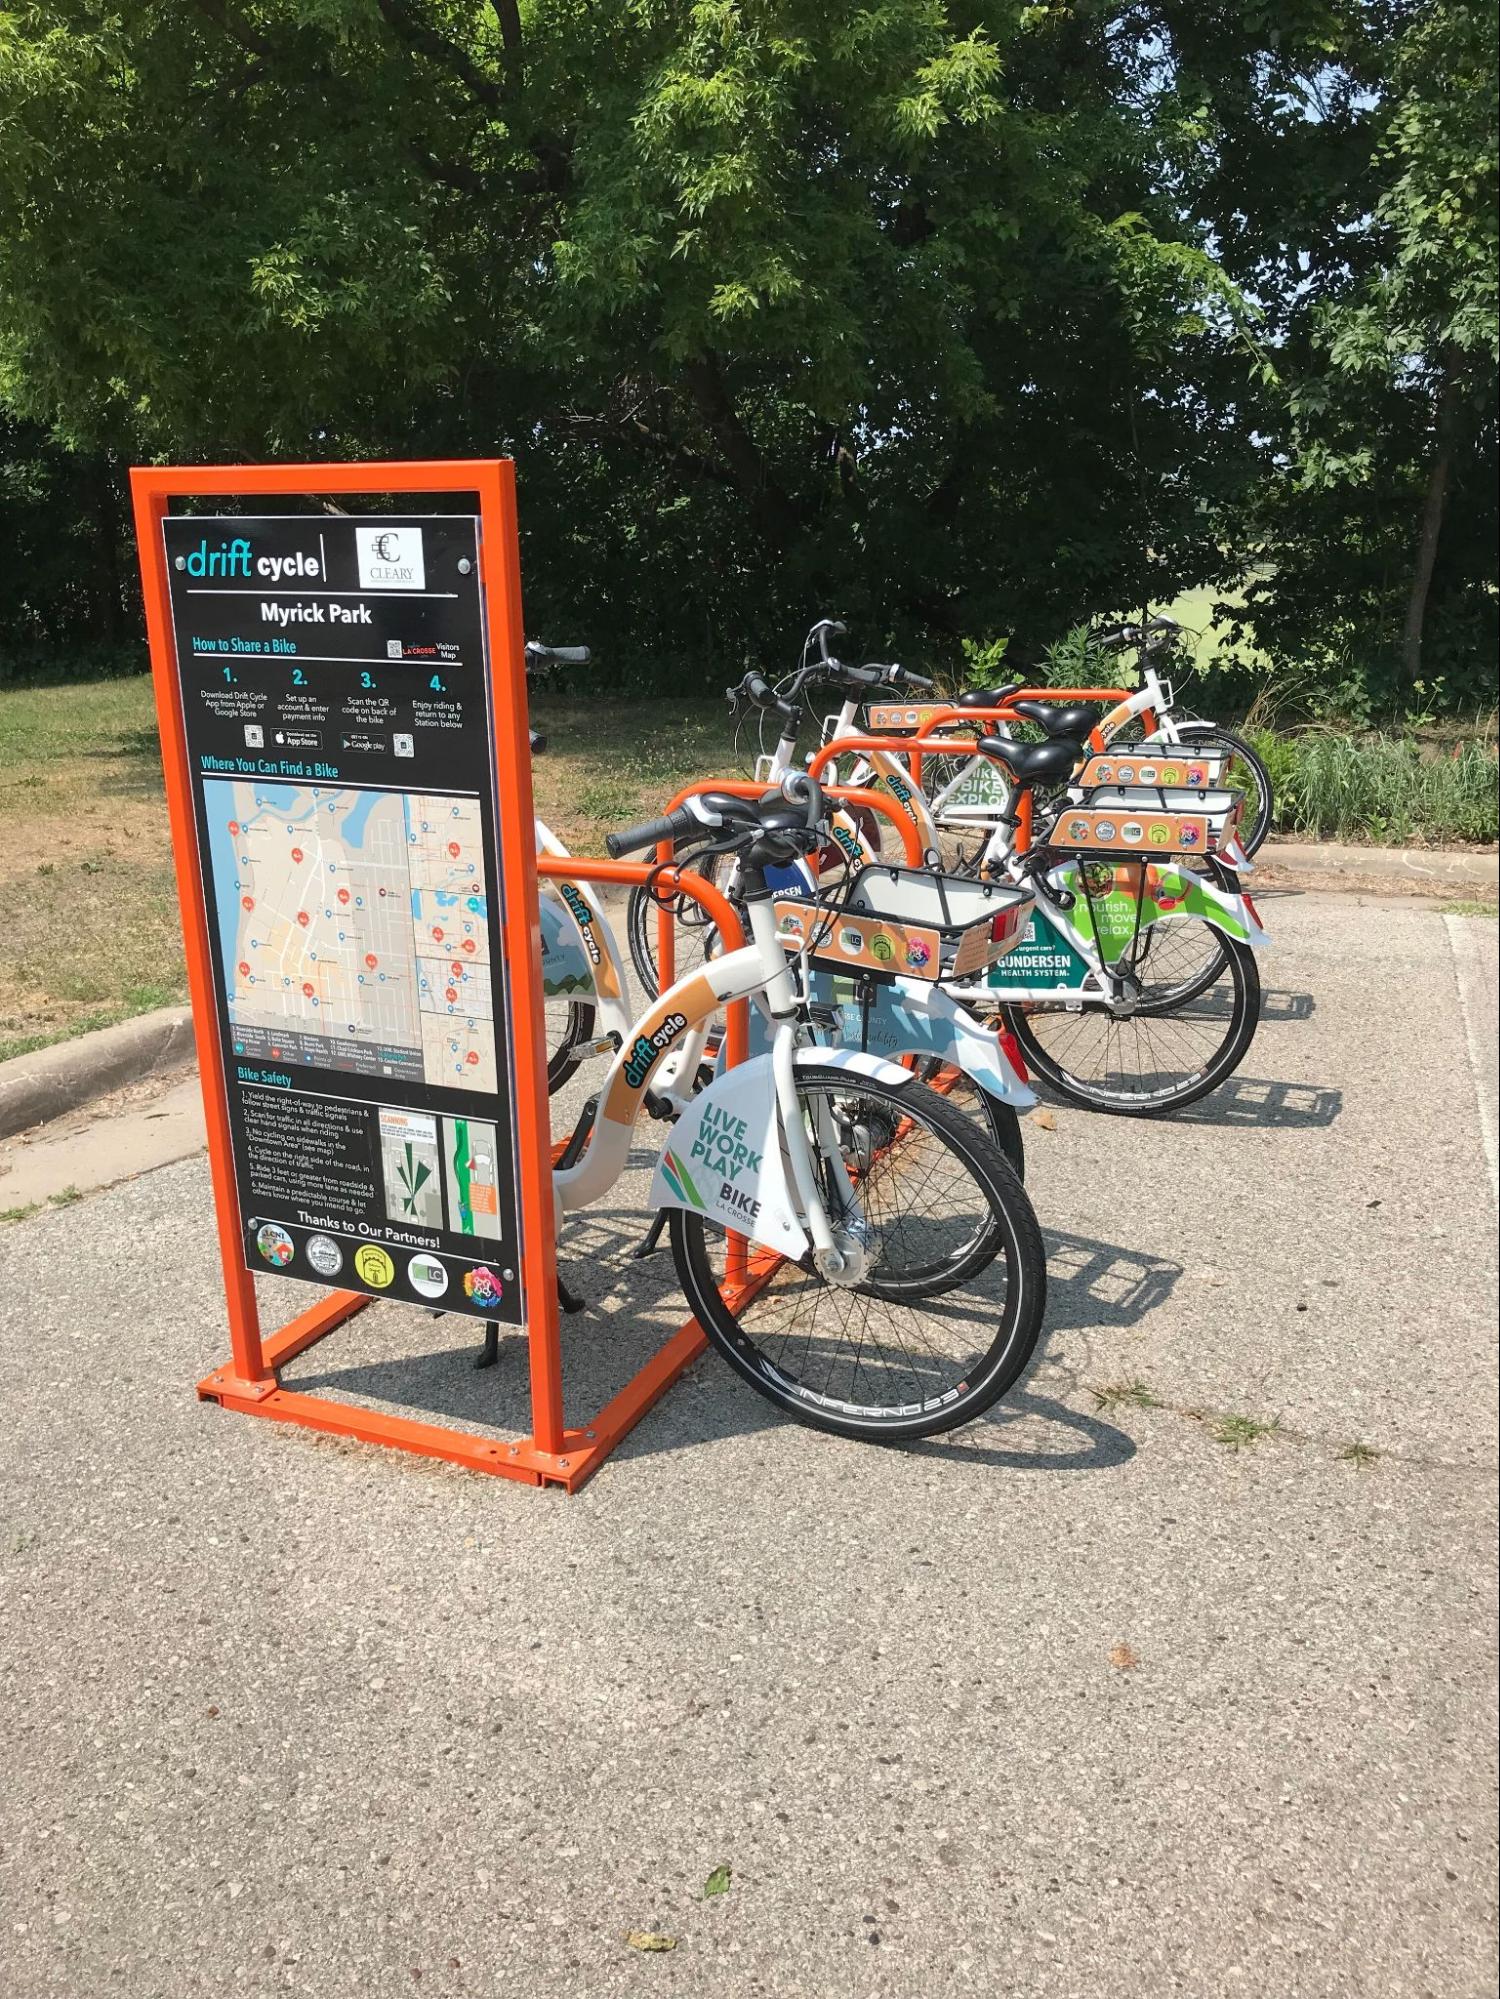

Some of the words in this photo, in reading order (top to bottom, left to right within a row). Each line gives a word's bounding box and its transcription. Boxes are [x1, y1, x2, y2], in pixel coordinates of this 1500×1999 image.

[187, 538, 252, 577] drift
[257, 551, 320, 581] cycle
[370, 567, 414, 580] CLEARY
[260, 602, 325, 627] Myrick
[329, 603, 373, 623] Park
[193, 637, 216, 651] How
[218, 640, 230, 651] to
[231, 638, 261, 652] Share
[263, 643, 271, 652] a
[272, 639, 297, 653] Bike
[412, 647, 437, 655] CROSSE
[435, 642, 460, 652] Visitors
[441, 650, 457, 660] Map
[223, 667, 238, 682] 1.
[293, 669, 308, 685] 2.
[360, 672, 377, 688] 3.
[429, 674, 447, 691] 4.
[200, 690, 233, 701] Download
[234, 691, 249, 701] Drift
[250, 691, 269, 704] Cycle
[286, 693, 298, 703] Set
[299, 696, 307, 706] up
[347, 696, 365, 706] Scan
[365, 698, 378, 706] the
[205, 700, 220, 710] App
[220, 700, 236, 709] from
[237, 701, 256, 711] Apple
[277, 703, 303, 712] account
[304, 704, 311, 712] &
[341, 705, 359, 714] code
[371, 707, 388, 716] back
[389, 707, 397, 716] of
[412, 700, 432, 710] Enjoy
[433, 701, 455, 712] riding
[456, 702, 463, 710] &
[214, 708, 239, 719] Google
[240, 710, 257, 718] Store
[282, 712, 312, 722] payment
[312, 713, 326, 722] info
[356, 714, 368, 723] the
[369, 715, 384, 724] bike
[415, 711, 437, 719] return
[438, 710, 446, 719] to
[447, 712, 461, 720] any
[414, 718, 439, 727] Station
[440, 719, 463, 728] below
[1101, 722, 1115, 739] ycle
[287, 737, 301, 747] App
[301, 737, 318, 747] Store
[350, 740, 372, 751] Google
[200, 755, 235, 771] Where
[235, 757, 256, 772] You
[258, 759, 278, 773] Can
[279, 761, 303, 775] Find
[305, 766, 312, 775] a
[314, 763, 339, 777] Bike
[887, 776, 910, 802] drift
[961, 780, 1002, 794] BIKE
[561, 885, 591, 925] drift
[582, 926, 599, 964] cycle
[1101, 914, 1137, 923] move
[997, 955, 1071, 968] GUNDERSEN
[1001, 969, 1033, 977] HEALTH
[626, 1038, 652, 1086] drift
[652, 1015, 686, 1048] cycle
[237, 1067, 260, 1083] Bike
[261, 1070, 292, 1089] Safety
[248, 1092, 264, 1101] Yield
[265, 1094, 276, 1102] the
[325, 1105, 362, 1116] pedestrians
[263, 1102, 280, 1110] street
[281, 1104, 298, 1113] signs
[250, 1110, 266, 1119] Scan
[312, 1120, 343, 1131] directions
[345, 1125, 350, 1133] &
[703, 1102, 748, 1141] LIVE
[278, 1121, 300, 1131] signals
[320, 1127, 339, 1139] riding
[253, 1128, 262, 1136] No
[263, 1130, 285, 1141] cycling
[296, 1135, 327, 1147] sidewalks
[335, 1142, 346, 1151] the
[699, 1121, 764, 1174] WORK
[255, 1146, 271, 1156] Cycle
[333, 1159, 343, 1168] the
[690, 1140, 743, 1182] PLAY
[311, 1200, 323, 1208] you
[719, 1182, 762, 1219] BIKE
[715, 1202, 726, 1212] LA
[726, 1206, 756, 1228] CROSSE
[297, 1210, 340, 1229] Thanks
[342, 1221, 356, 1232] to
[358, 1222, 382, 1237] Our
[385, 1227, 441, 1248] Partners!
[800, 1386, 922, 1418] INFERNO
[923, 1388, 960, 1412] 23
